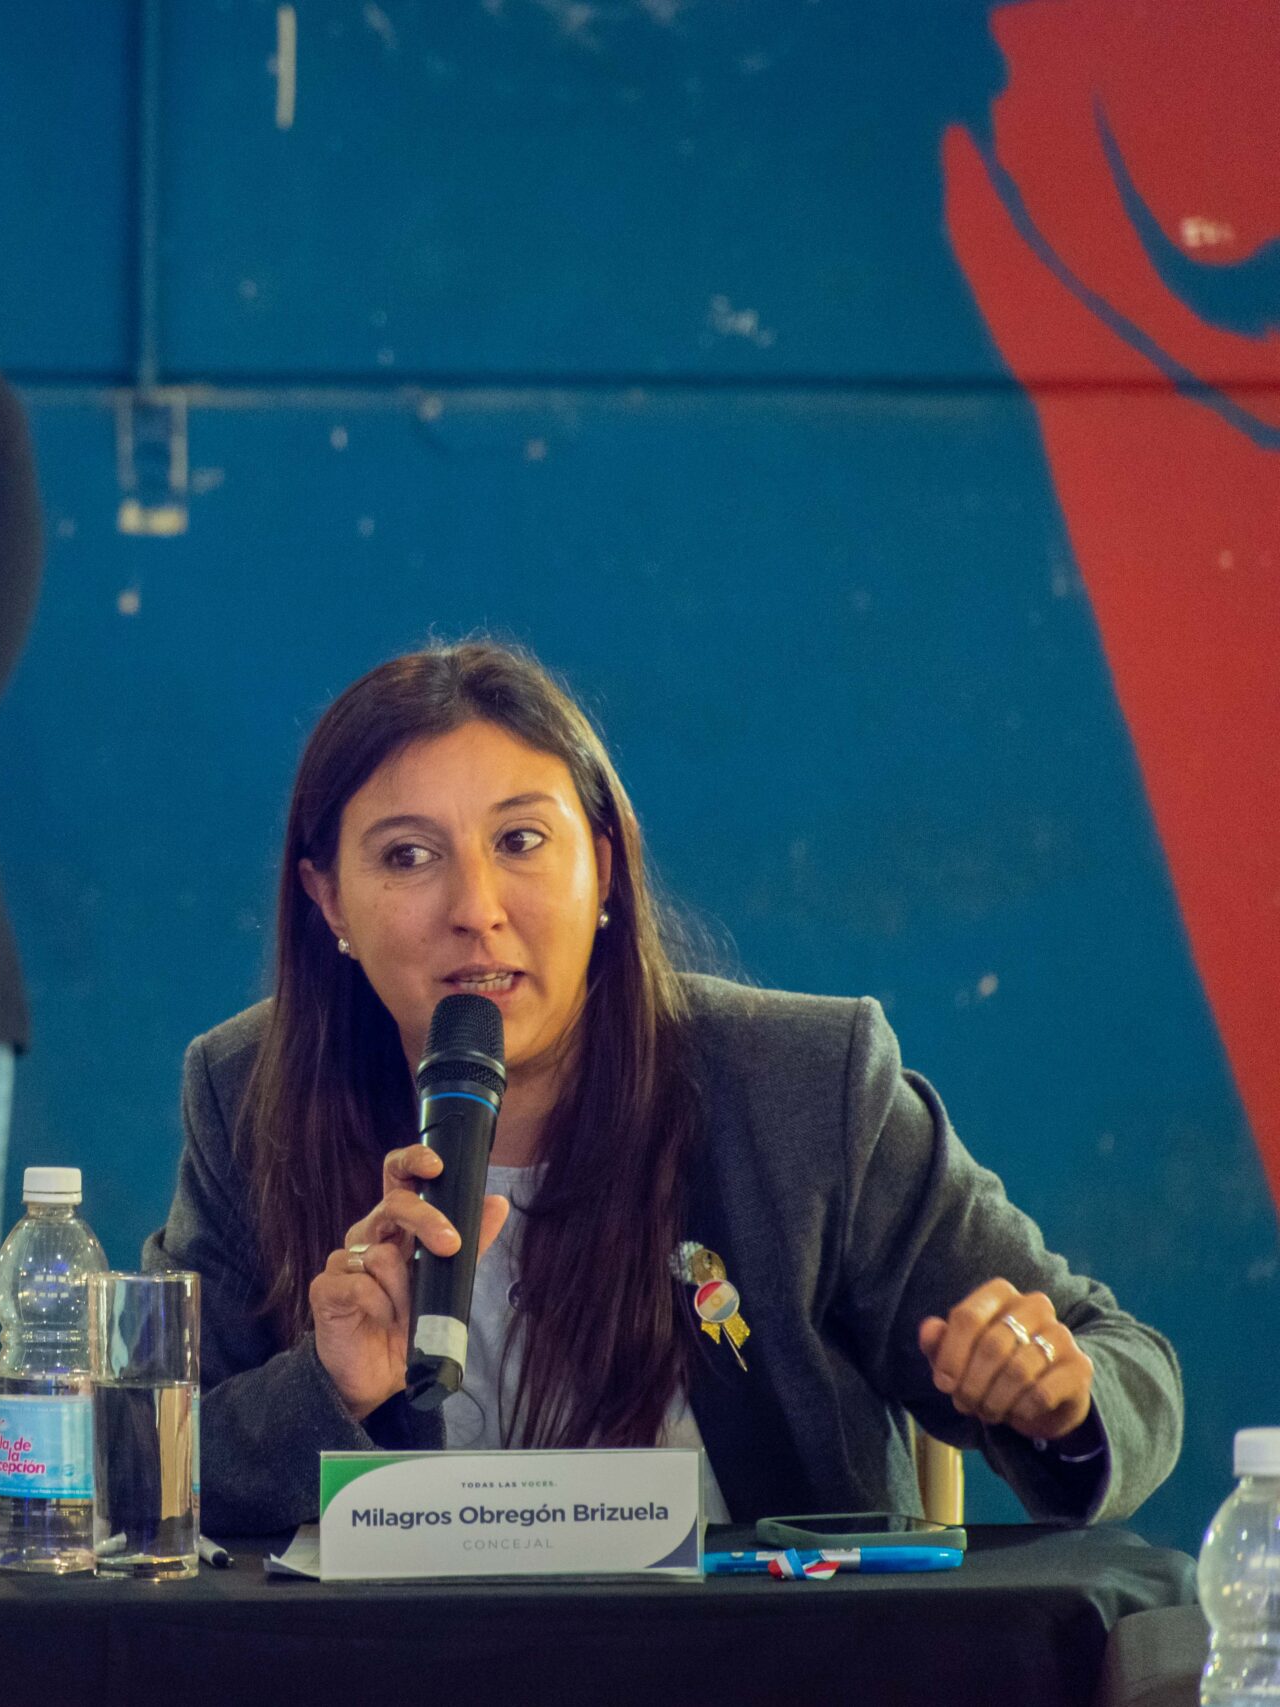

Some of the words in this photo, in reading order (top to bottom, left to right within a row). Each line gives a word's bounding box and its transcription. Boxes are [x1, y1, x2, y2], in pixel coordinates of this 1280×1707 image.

[14, 1437, 31, 1452] de
[7, 1448, 20, 1462] la
[461, 1481, 495, 1489] TODAS
[351, 1507, 452, 1530] Milagros
[458, 1503, 566, 1527] Obregón
[573, 1502, 669, 1522] Brizuela
[462, 1537, 554, 1551] CONCEJAL
